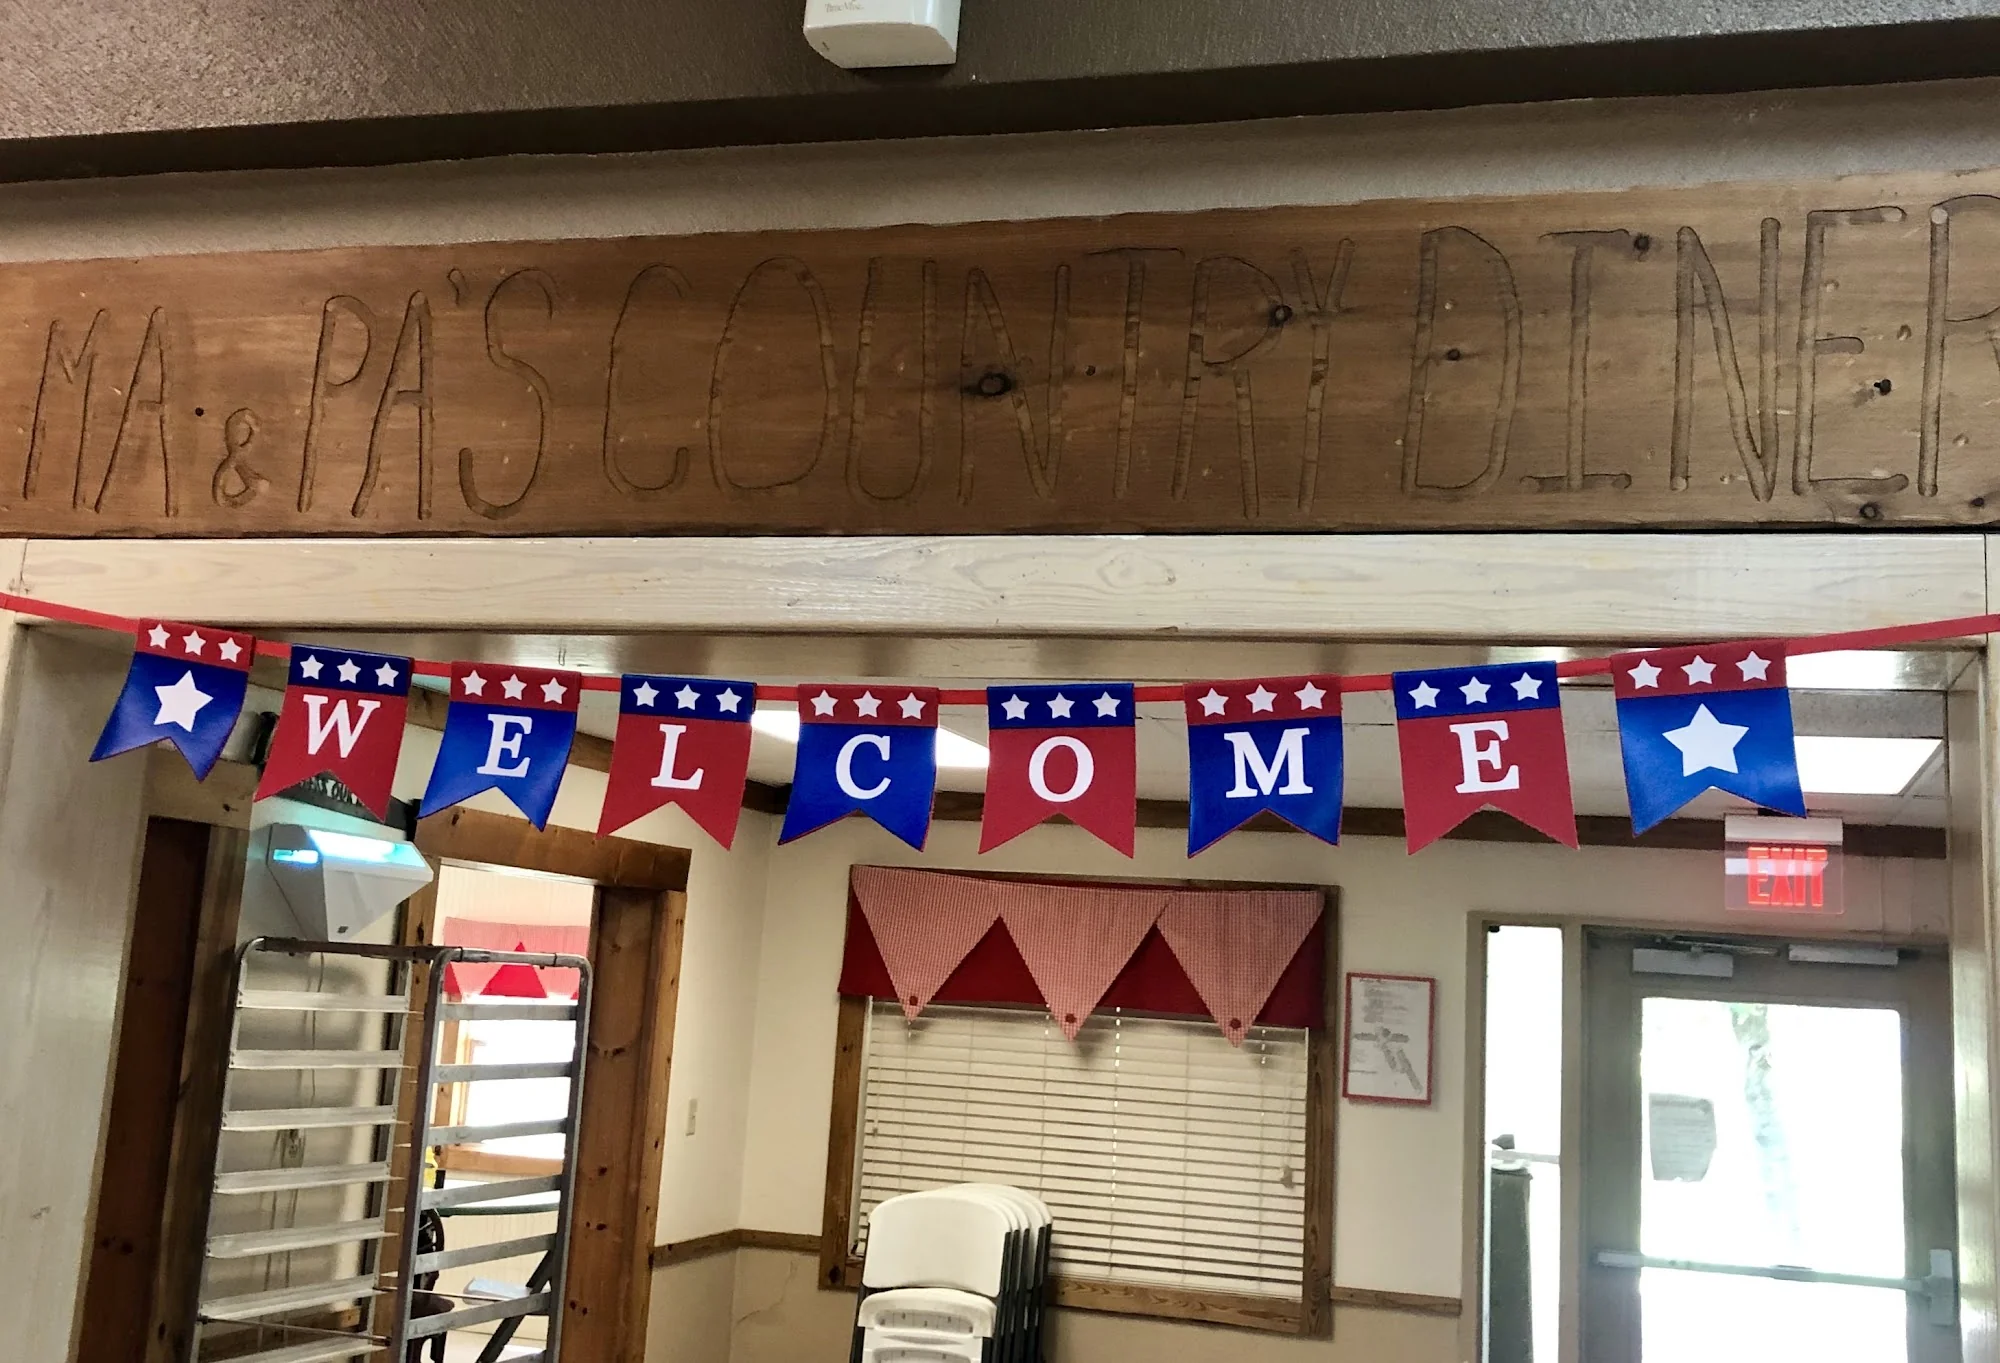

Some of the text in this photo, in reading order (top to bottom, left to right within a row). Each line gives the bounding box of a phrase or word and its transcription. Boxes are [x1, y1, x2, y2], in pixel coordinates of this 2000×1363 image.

[23, 304, 179, 517] MA
[211, 407, 270, 507] &
[297, 266, 560, 519] PA'S
[602, 237, 1355, 520] COUNTRY
[1747, 846, 1828, 907] EXIT
